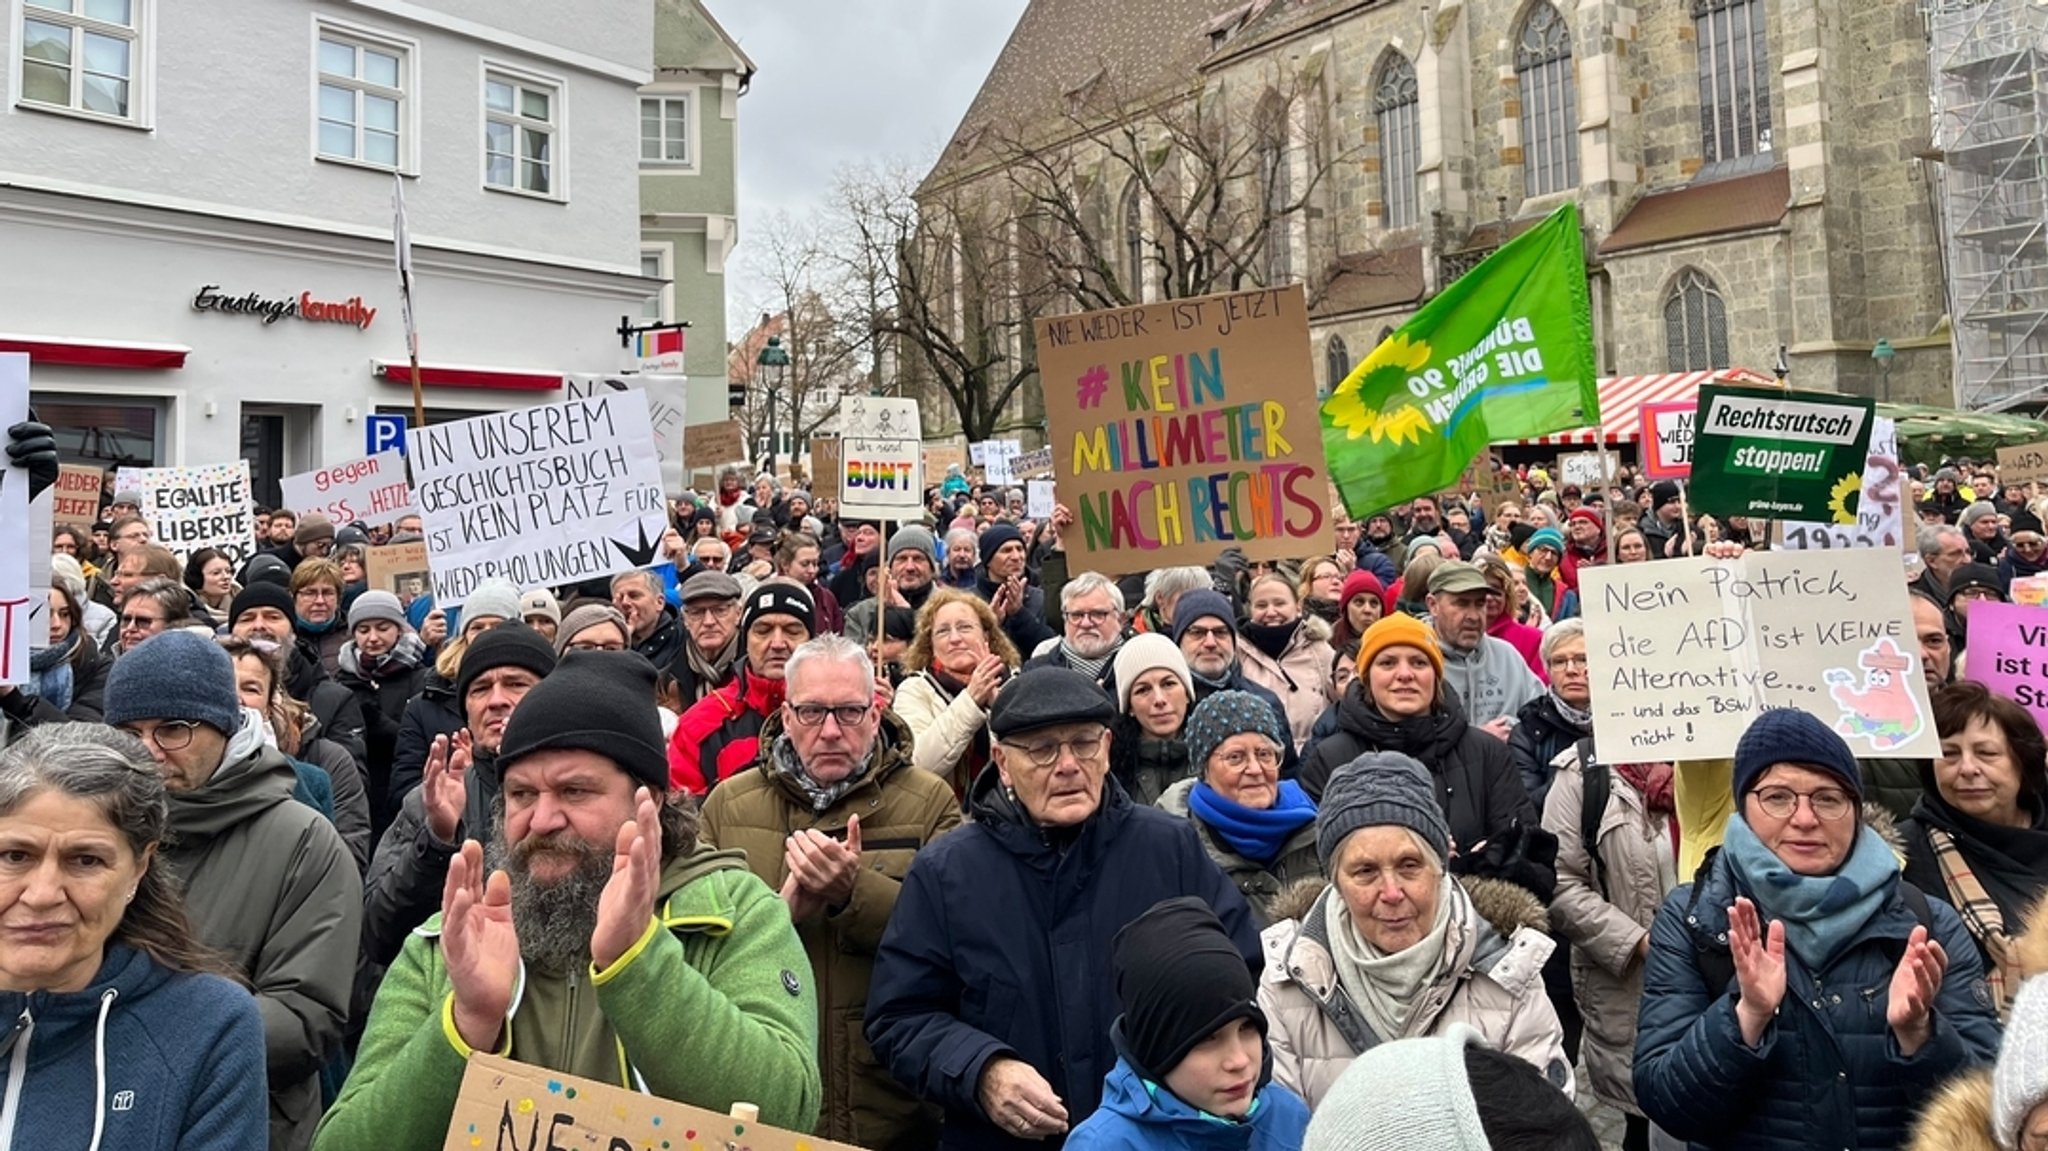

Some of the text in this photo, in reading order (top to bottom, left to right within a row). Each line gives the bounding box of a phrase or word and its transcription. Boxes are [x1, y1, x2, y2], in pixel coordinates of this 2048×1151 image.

[194, 285, 377, 330] Ernsting's family
[1048, 321, 1074, 347] NIE
[1081, 308, 1149, 342] WIEDER
[1171, 302, 1206, 331] IST
[1213, 287, 1292, 335] JETZT
[1121, 348, 1225, 412] KEIN
[375, 420, 397, 451] P
[416, 398, 615, 471] IN UNSEREM
[1073, 400, 1293, 475] MILLIMETER
[1715, 404, 1852, 437] Rechtsrutsch
[315, 458, 380, 492] gegen
[847, 459, 912, 491] BUNT
[1734, 446, 1826, 474] stoppen!
[155, 474, 242, 509] EGALITÉ
[370, 482, 411, 515] HETZE
[420, 445, 629, 514] GESCHICHTSBUCH
[157, 504, 246, 542] LIBERTÉ
[428, 482, 664, 552] IST KEIN PLATZ FÜR
[1079, 463, 1322, 551] NACH RECHTS
[1605, 567, 1857, 613] Nein Patrick,
[1609, 617, 1902, 658] die AfD ist KEINE
[1996, 652, 2030, 676] ist
[1633, 702, 1664, 718] und
[1672, 704, 1701, 716] das
[1706, 696, 1752, 714] BSW
[1630, 730, 1675, 749] nicht
